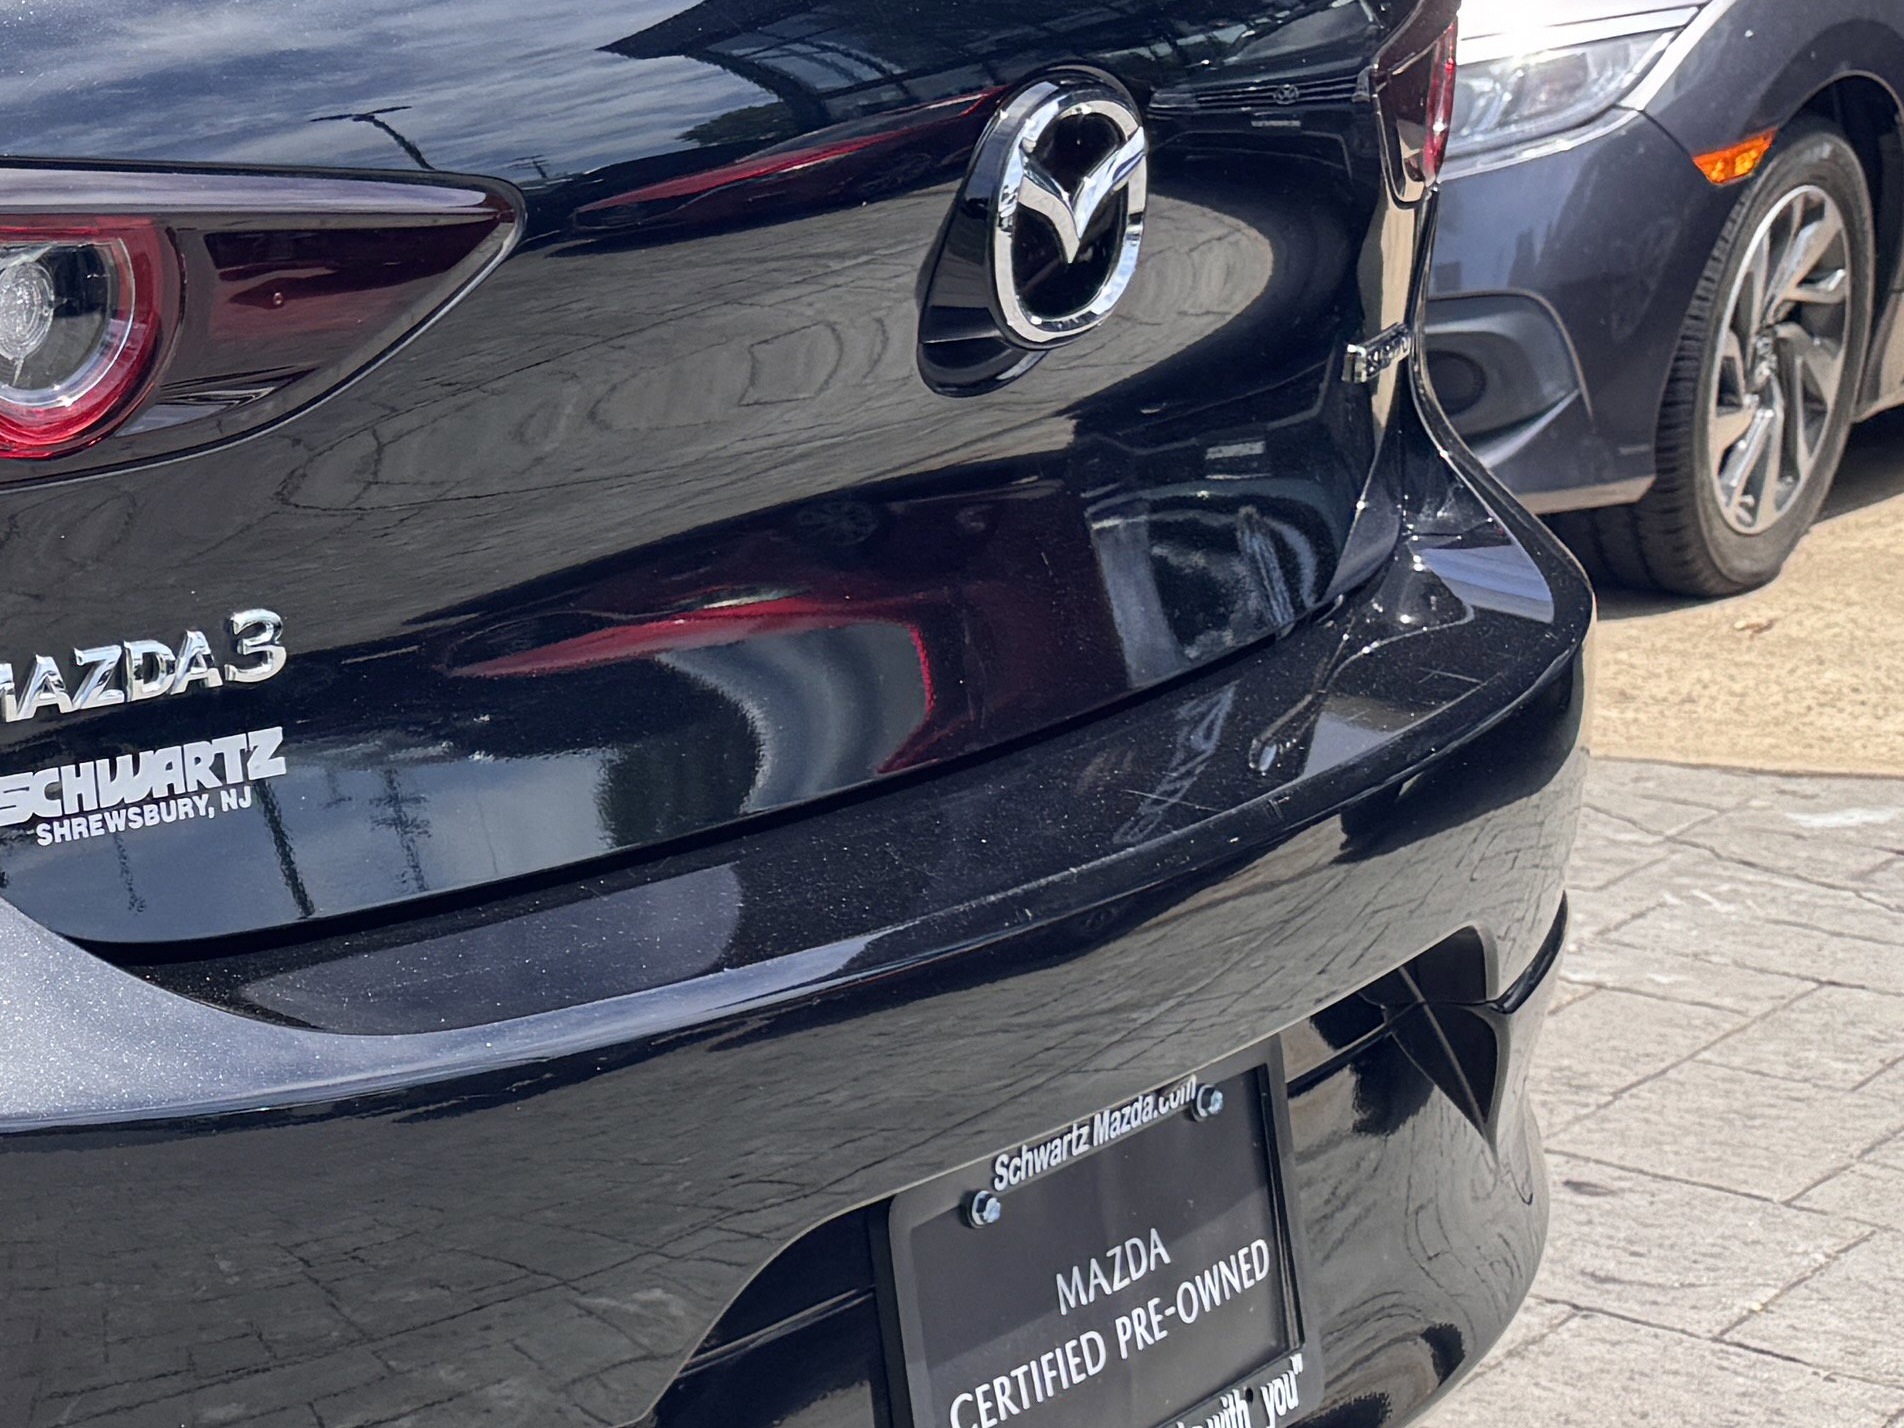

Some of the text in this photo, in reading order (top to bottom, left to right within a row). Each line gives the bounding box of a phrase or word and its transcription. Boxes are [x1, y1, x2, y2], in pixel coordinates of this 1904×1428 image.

[36, 786, 253, 846] SHREWSBURY, NJ
[993, 1124, 1091, 1192] Schwartz
[1056, 1228, 1172, 1316] MAZDA
[1115, 1238, 1271, 1360] PRE-OWNED
